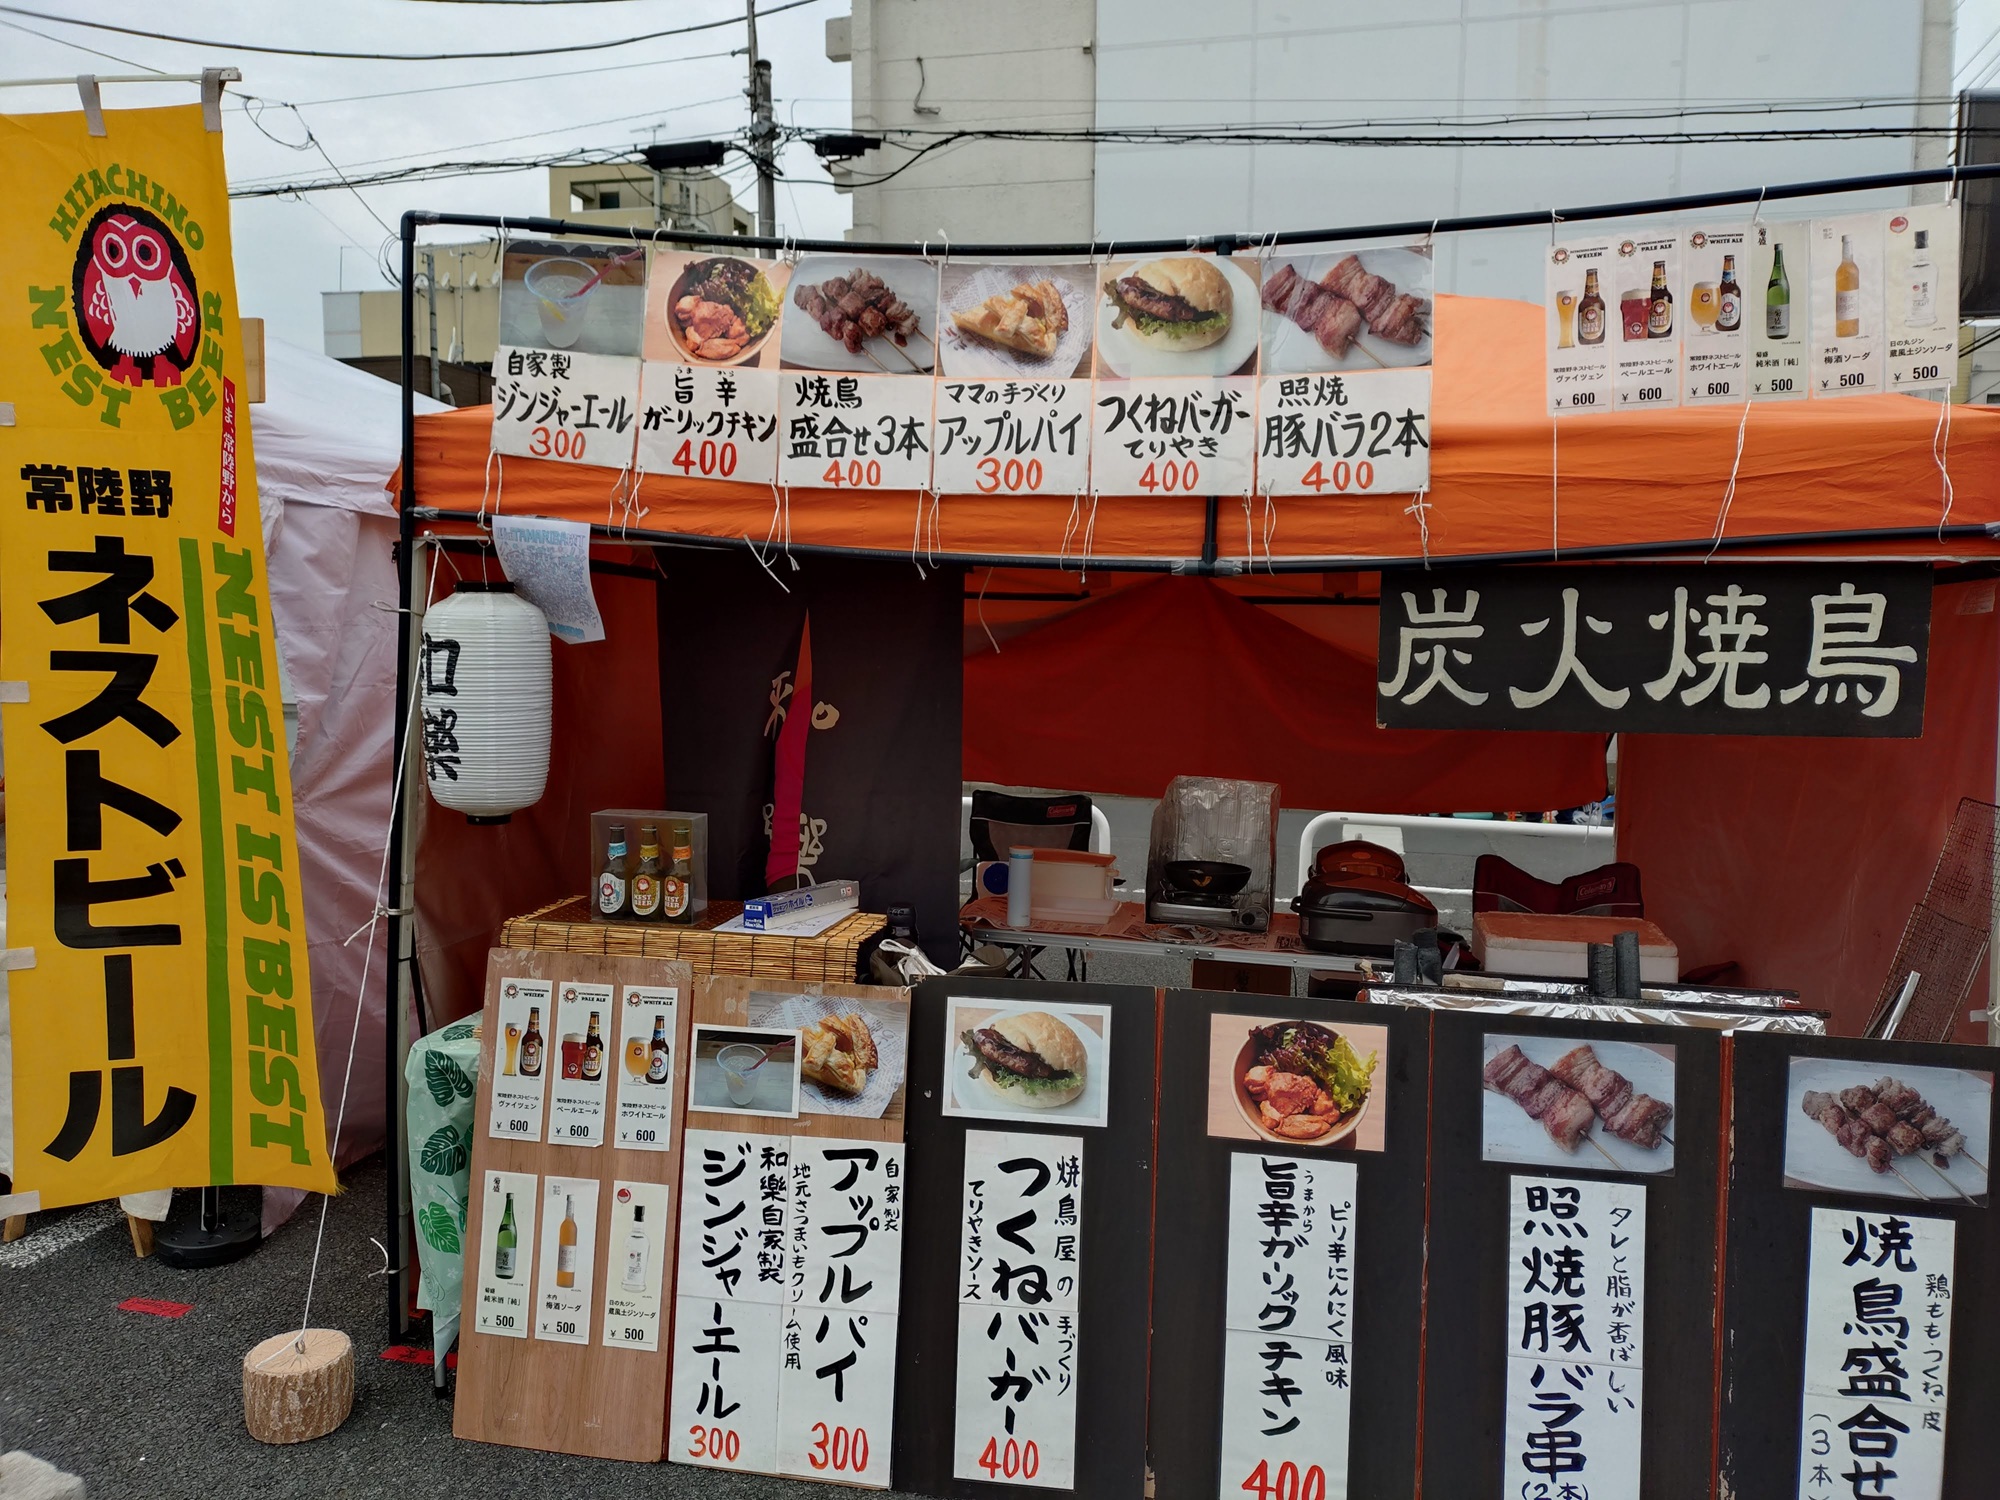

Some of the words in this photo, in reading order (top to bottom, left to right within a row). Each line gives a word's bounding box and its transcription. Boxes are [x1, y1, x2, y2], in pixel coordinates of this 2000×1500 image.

[49, 163, 204, 250] HITACHINO
[28, 285, 132, 428] NEST
[159, 291, 223, 431] BEER
[1824, 352, 1871, 365] 梅酒ソーダ
[1889, 337, 1926, 347] 日の丸ジン
[507, 349, 572, 381] 自家製
[1620, 367, 1673, 378] ペールエール
[1689, 361, 1741, 372] ホワイトエール
[1839, 372, 1865, 387] 500
[1912, 365, 1938, 380] 500
[794, 376, 862, 409] 焼鳥
[944, 382, 1068, 405] ママの手づくり
[1278, 376, 1349, 407] 照焼
[1572, 392, 1595, 406] 600
[1638, 387, 1662, 401] 600
[1707, 382, 1730, 395] 600
[1771, 378, 1793, 392] 500
[496, 385, 635, 434] ジンジャーエール
[643, 406, 778, 442] ガーリックチキン
[1097, 390, 1251, 436] つくねバーガー
[528, 427, 586, 460] 300
[787, 414, 929, 460] 盛合せ3本
[937, 409, 1084, 457] アップルパイ
[1124, 436, 1220, 459] てりやき
[1261, 408, 1429, 459] 豚バラ2本
[222, 387, 235, 524] いま、常陸野から
[672, 439, 738, 478] 400
[822, 459, 882, 488] 400
[20, 463, 173, 518] 常陸野
[975, 457, 1044, 493] 300
[1138, 460, 1199, 493] 400
[1300, 460, 1374, 492] 400
[1378, 582, 1918, 717] 炭火焼鳥
[212, 541, 281, 816] NEST
[37, 535, 197, 1162] ネストビール
[236, 823, 291, 932] IS
[243, 937, 312, 1166] BEST
[509, 1119, 529, 1132] 600
[569, 1125, 589, 1137] 600
[621, 1110, 666, 1119] ホワイトエール
[635, 1129, 656, 1142] 600
[883, 1157, 901, 1233] 自家製
[1301, 1169, 1315, 1234] うまから
[756, 1146, 788, 1286] 和樂自家製
[963, 1180, 986, 1300] てりやきソース
[692, 1141, 752, 1420] ジンジャーエール
[783, 1163, 811, 1371] 地元さつまいもクリーム使用
[815, 1148, 880, 1403] アップルパイ
[545, 1301, 582, 1312] 梅酒ソーダ
[986, 1156, 1053, 1435] つくねバーガー
[1325, 1200, 1352, 1389] ピリ辛にんにく風味
[1606, 1207, 1636, 1414] タレと脂が香ばしい
[495, 1315, 515, 1328] 500
[556, 1321, 576, 1334] 500
[624, 1328, 644, 1341] 500
[1521, 1185, 1594, 1484] 照焼豚バラ串
[1838, 1215, 1918, 1500] 焼鳥盛合せ
[687, 1424, 741, 1462] 300
[808, 1421, 870, 1473] 300
[978, 1436, 1040, 1480] 400
[1241, 1458, 1326, 1500] 400
